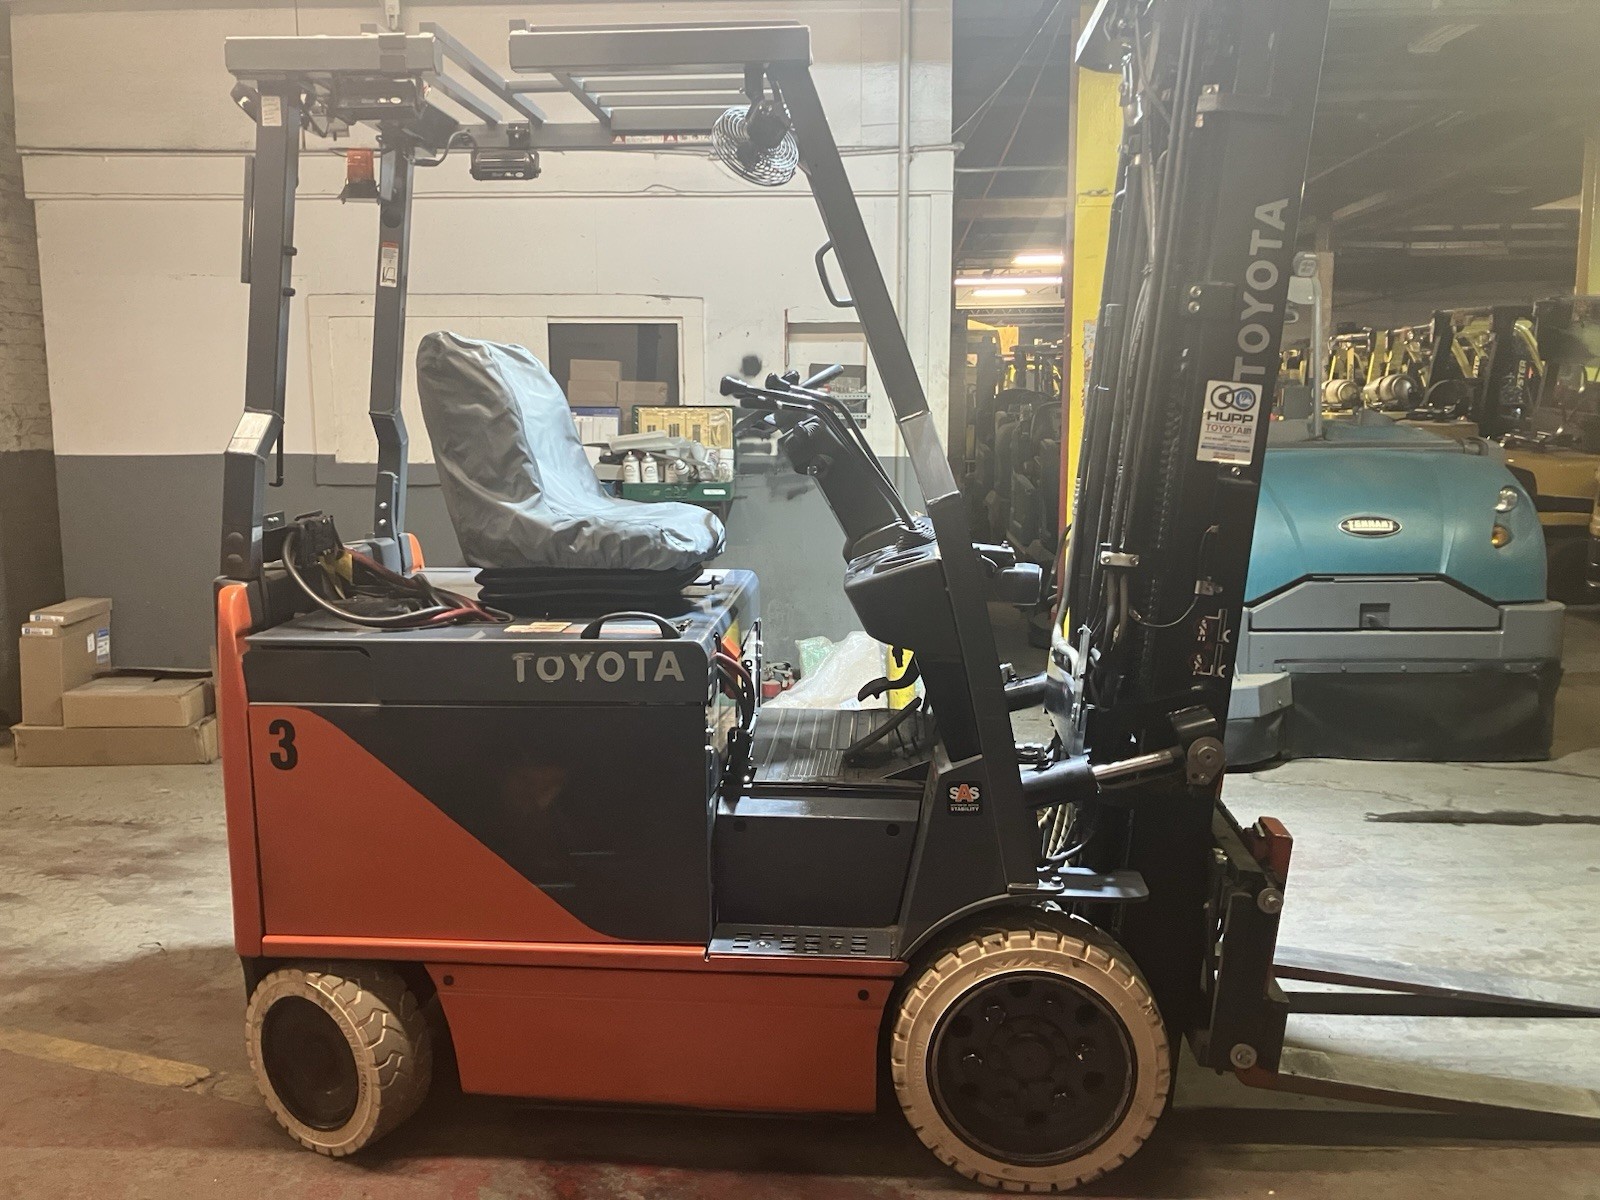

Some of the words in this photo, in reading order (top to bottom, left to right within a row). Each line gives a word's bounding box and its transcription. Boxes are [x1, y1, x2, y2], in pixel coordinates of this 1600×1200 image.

[1233, 198, 1289, 381] TOYOTA
[1207, 411, 1254, 423] HUPP
[512, 651, 685, 683] TOYOTA
[269, 719, 298, 770] 3
[949, 784, 980, 802] SAS
